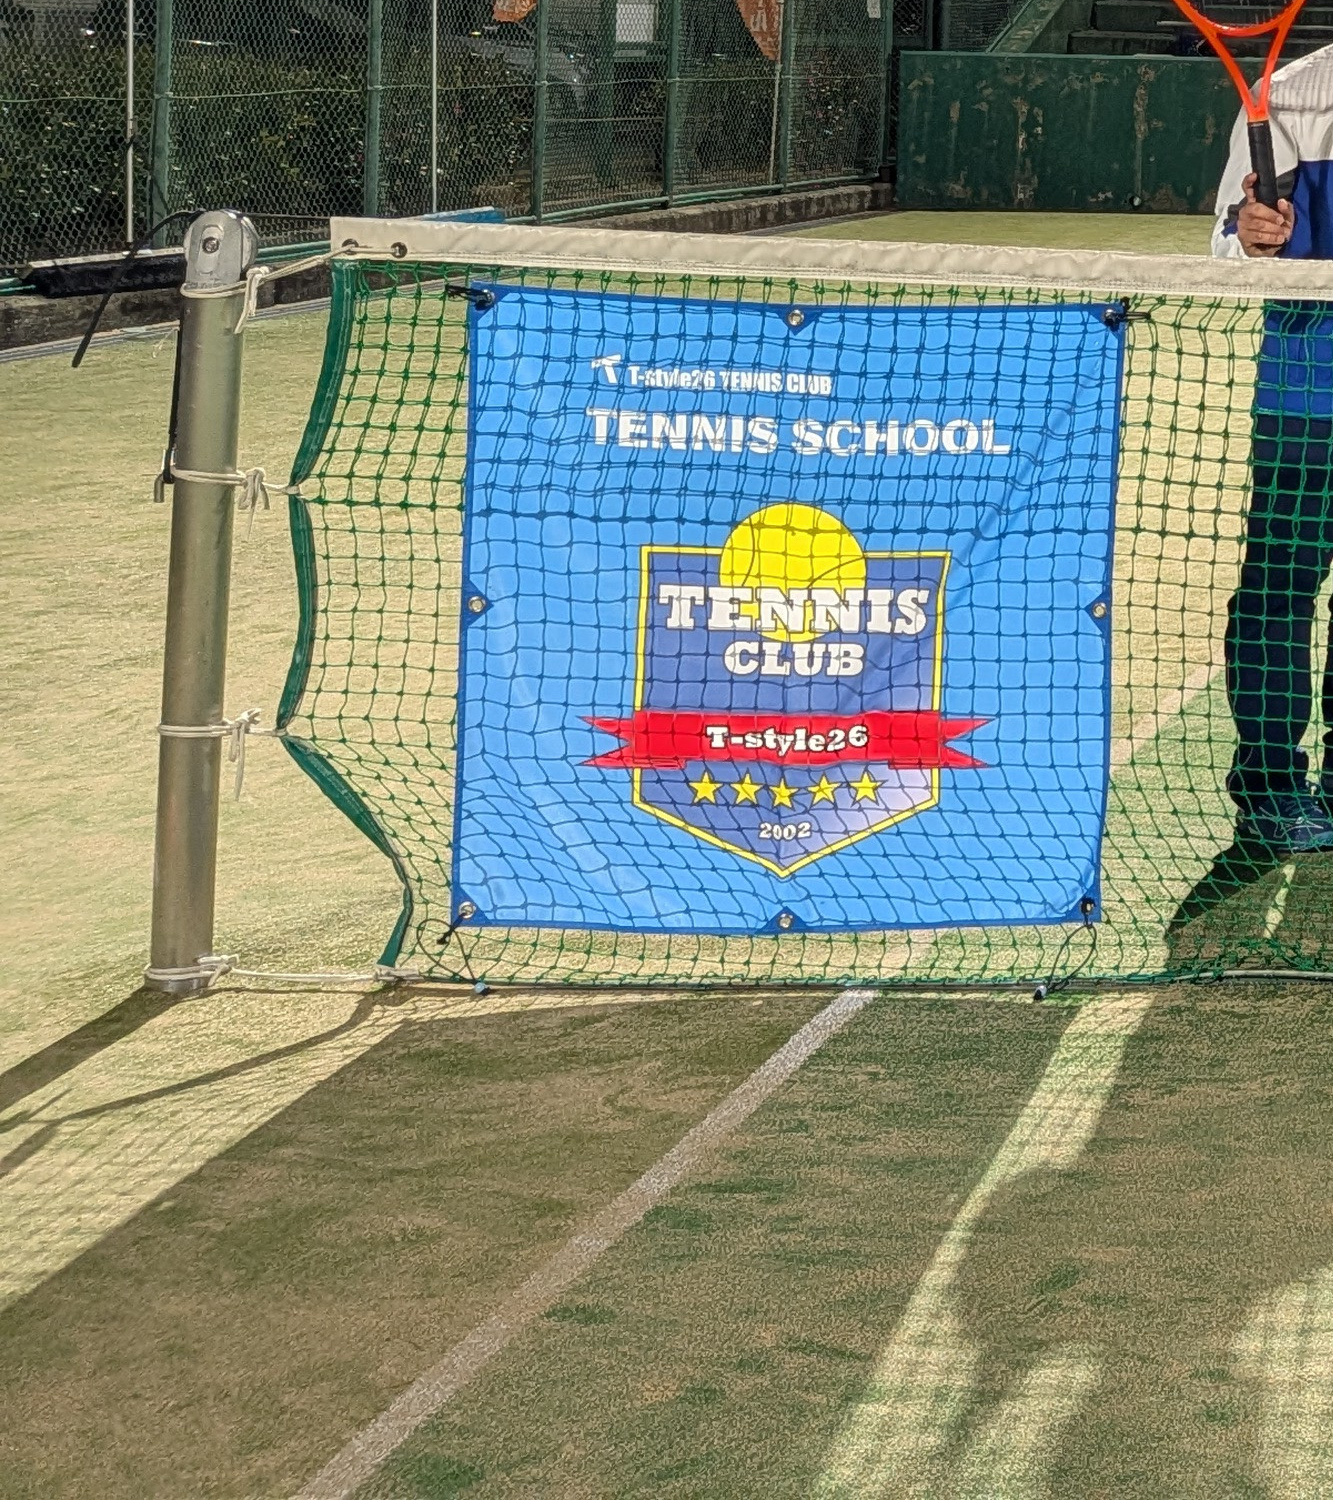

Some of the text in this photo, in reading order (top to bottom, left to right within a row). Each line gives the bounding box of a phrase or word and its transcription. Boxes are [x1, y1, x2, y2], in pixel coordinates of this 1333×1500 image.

[628, 366, 716, 391] T-style26
[719, 370, 782, 393] TENNIS
[786, 372, 832, 396] CLUB
[586, 407, 1011, 457] TENNIS SCHOOL
[659, 584, 930, 635] TENNIS
[723, 641, 865, 676] CLUB
[706, 725, 868, 757] T-style26
[759, 822, 811, 841] 2002
